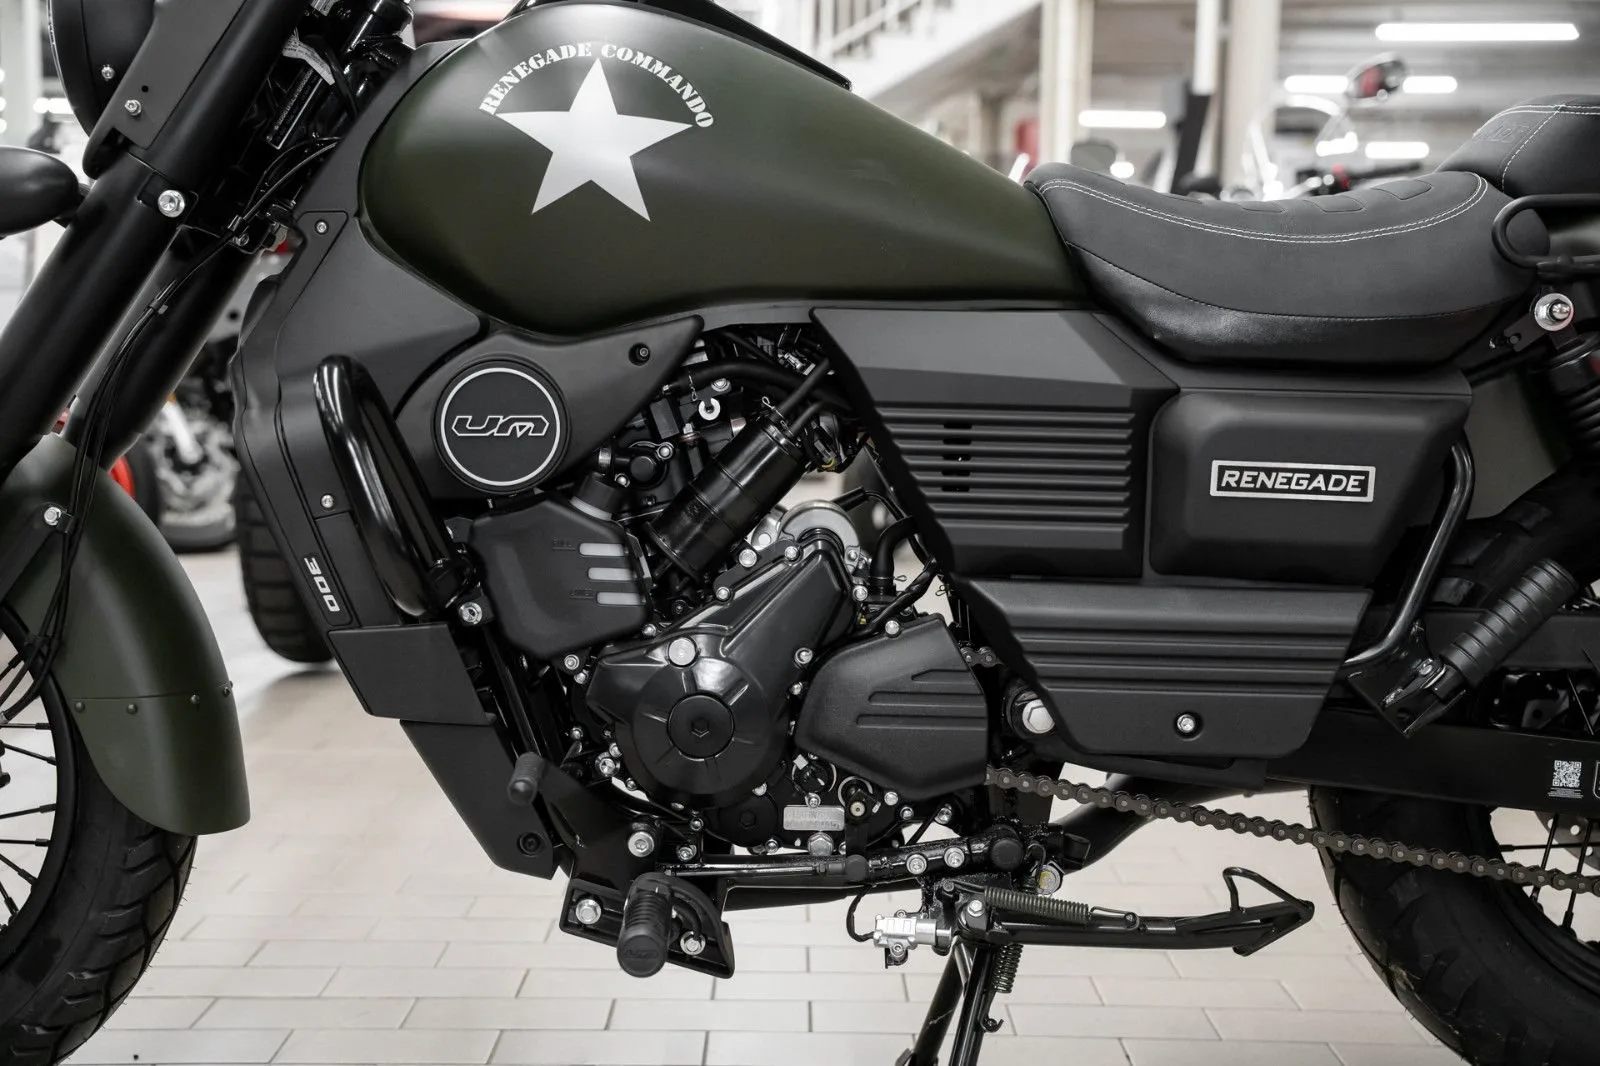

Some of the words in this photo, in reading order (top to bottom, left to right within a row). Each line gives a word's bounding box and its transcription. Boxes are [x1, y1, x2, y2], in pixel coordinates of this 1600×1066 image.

[479, 42, 592, 115] RENEGADE
[601, 44, 714, 128] COMMANDO
[1220, 470, 1365, 493] RENEGADE
[303, 557, 340, 612] 300
